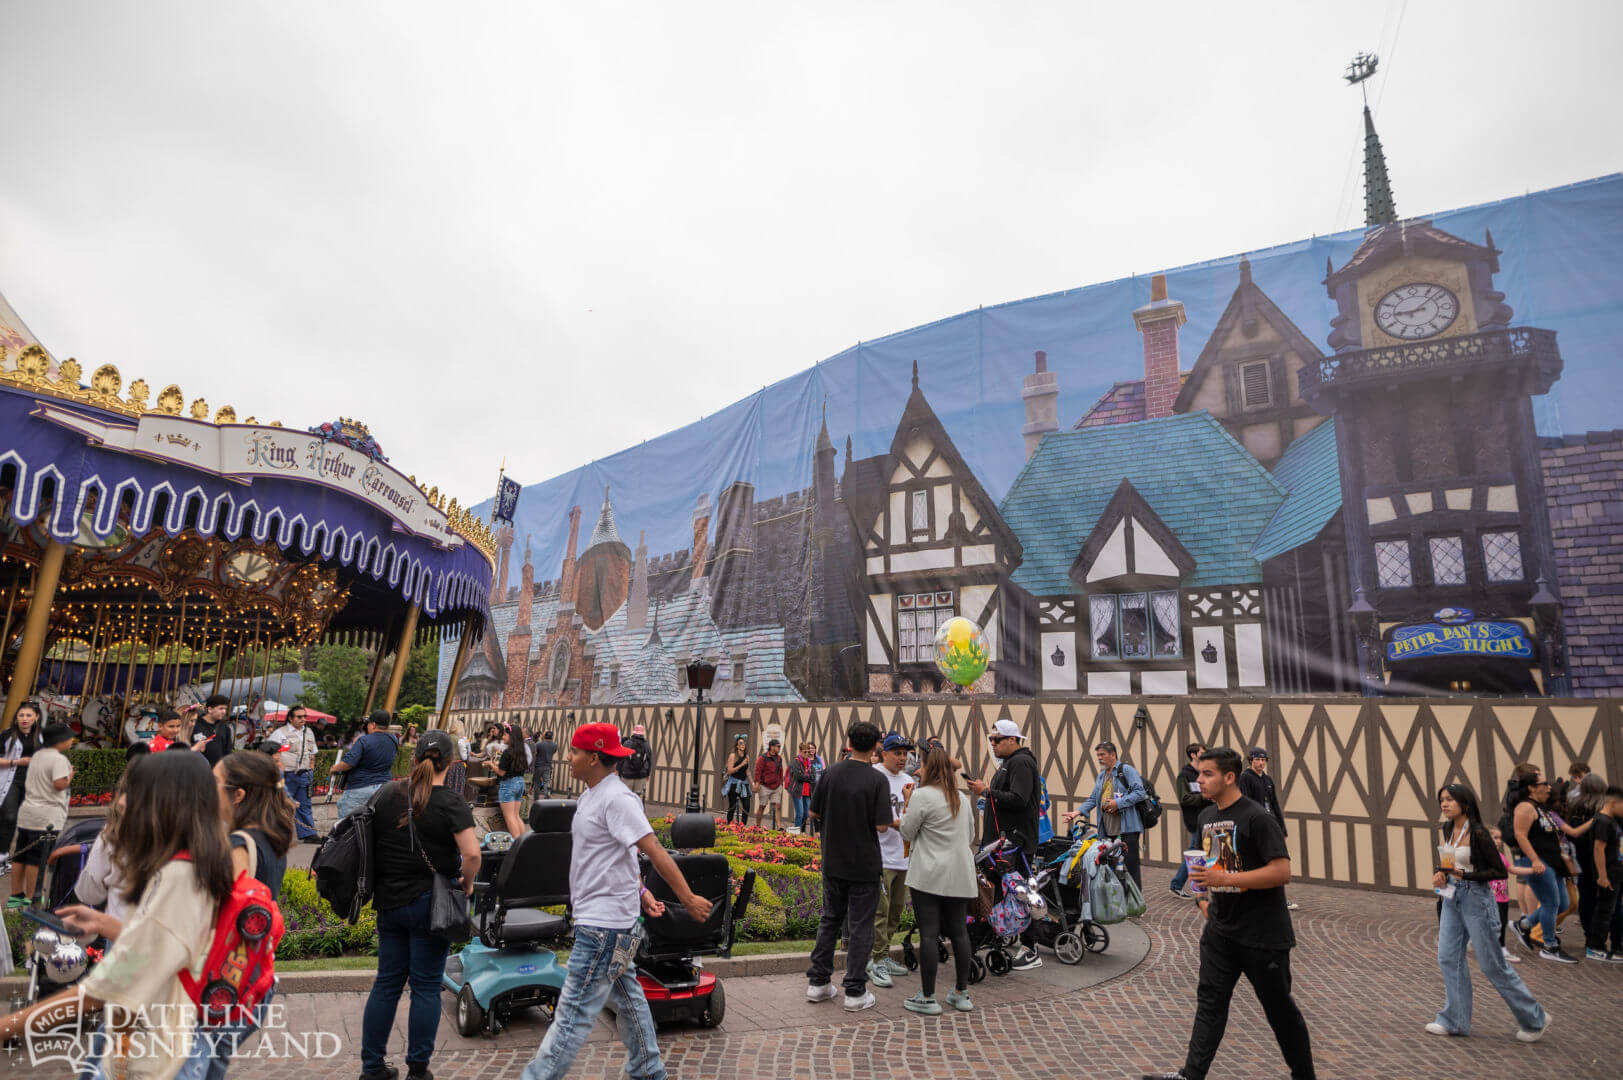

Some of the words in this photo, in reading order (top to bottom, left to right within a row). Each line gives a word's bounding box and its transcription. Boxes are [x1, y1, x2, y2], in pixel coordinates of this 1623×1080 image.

[247, 431, 298, 470] King
[307, 440, 356, 480] Arthur
[359, 466, 415, 514] Carrousel
[1393, 632, 1441, 654] PETER
[1443, 624, 1489, 641] PAN'S
[1463, 635, 1524, 653] FLIGHT
